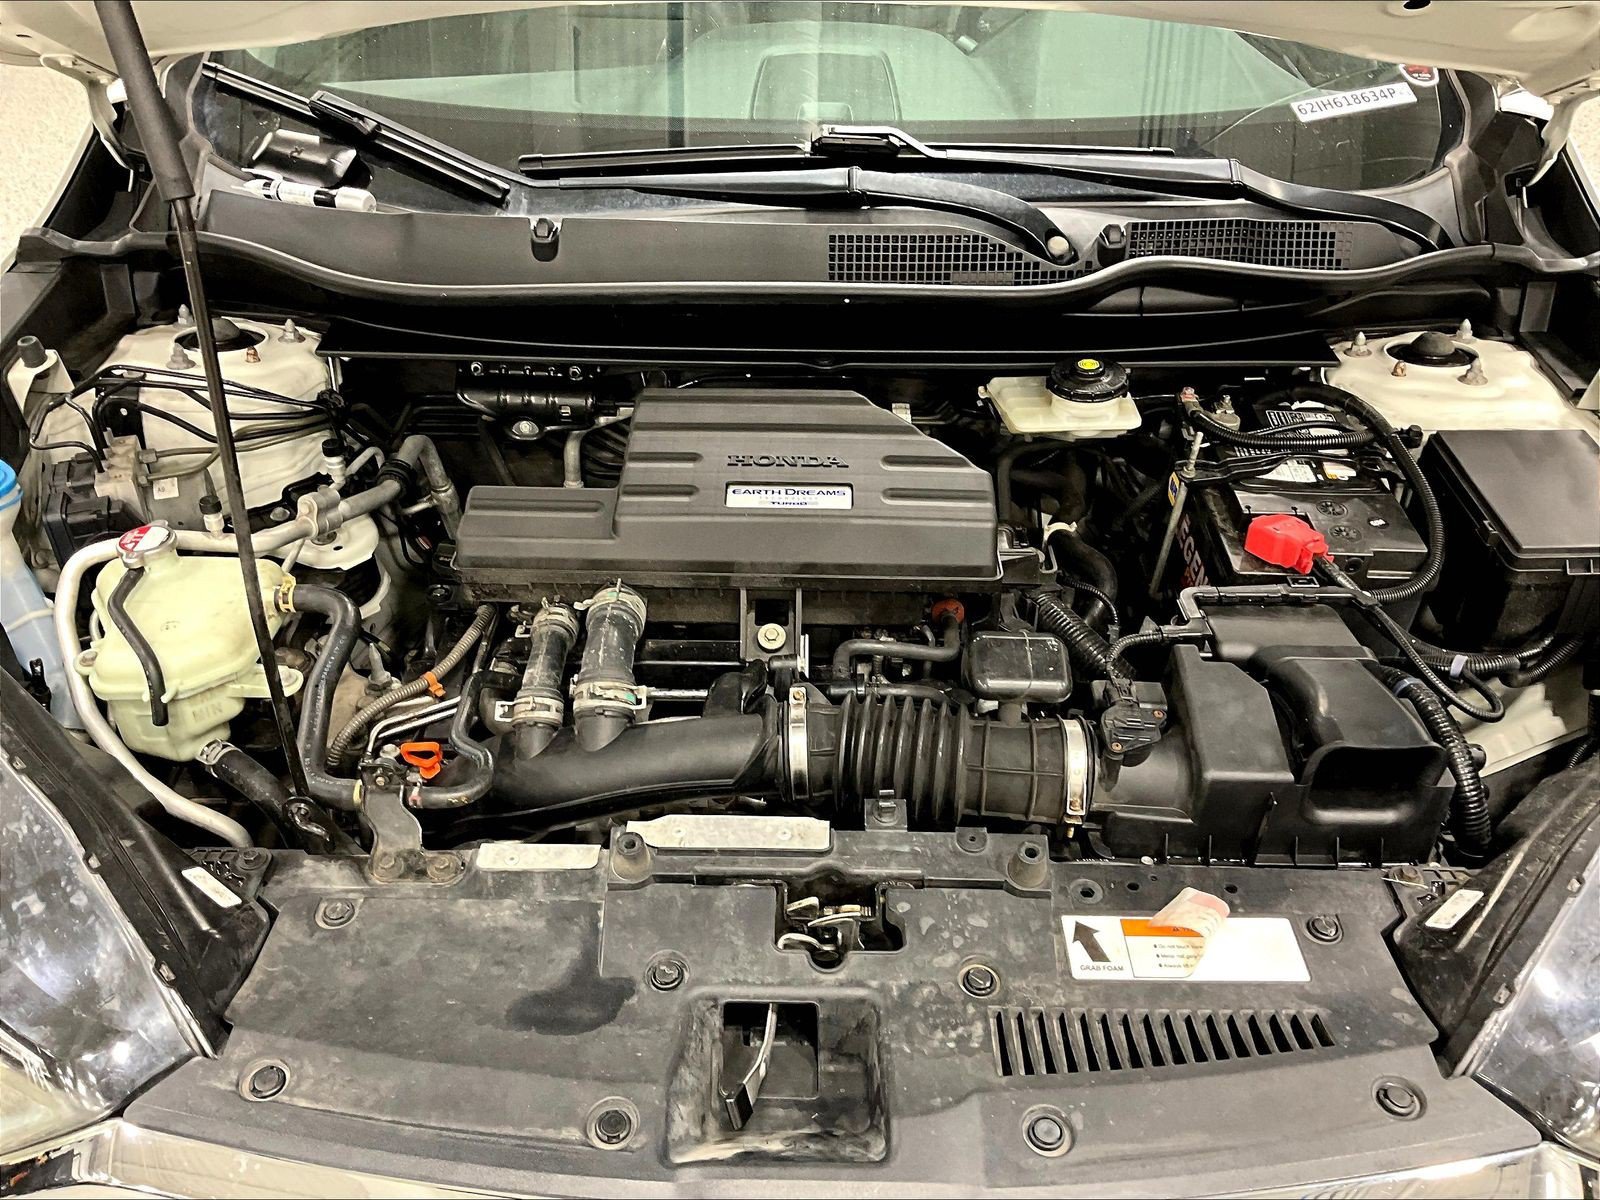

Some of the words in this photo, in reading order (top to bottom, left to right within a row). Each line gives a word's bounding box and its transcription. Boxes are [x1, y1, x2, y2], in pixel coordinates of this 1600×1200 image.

[727, 454, 849, 469] HONDA
[731, 488, 782, 496] EARTH
[784, 488, 847, 497] DREAMS
